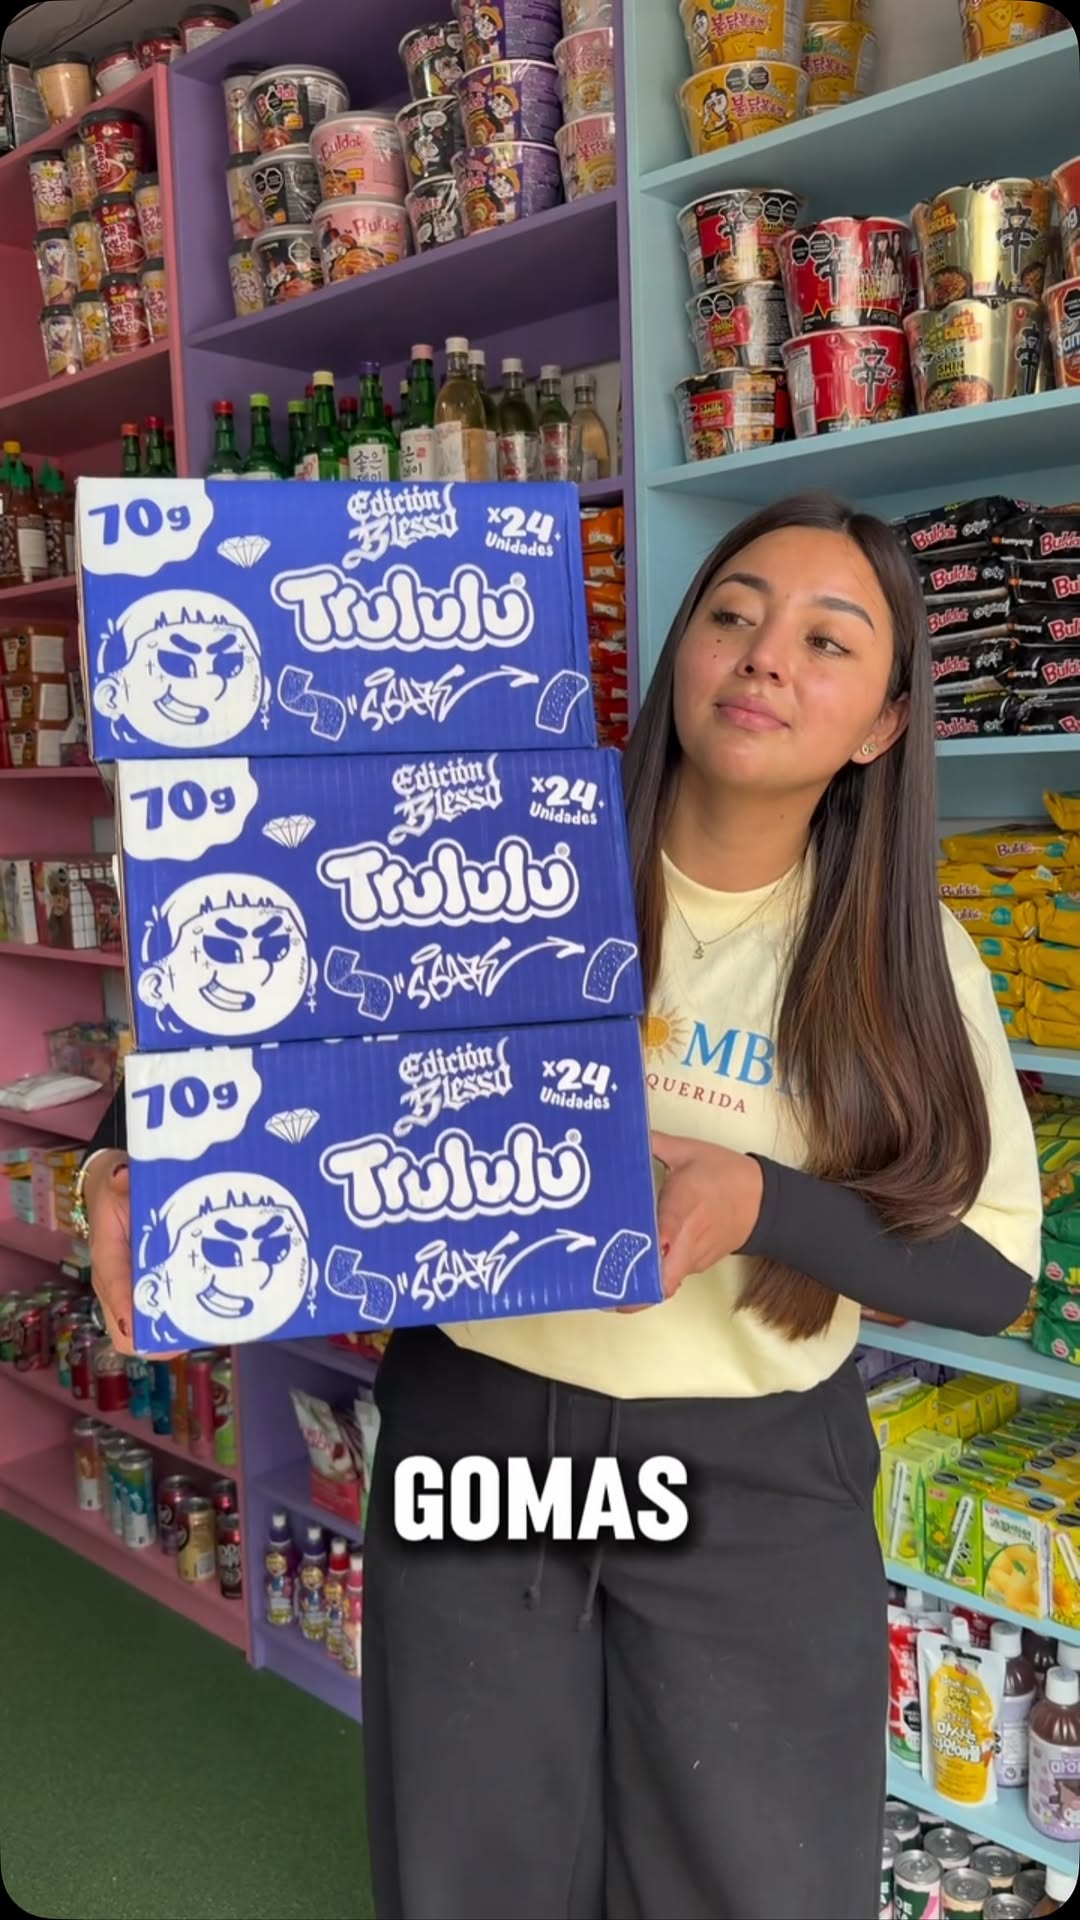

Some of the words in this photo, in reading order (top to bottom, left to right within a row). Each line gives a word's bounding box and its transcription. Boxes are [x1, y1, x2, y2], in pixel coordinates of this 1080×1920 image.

[938, 360, 965, 374] SHIN
[88, 499, 191, 546] 70g
[347, 484, 442, 522] Edición
[485, 530, 554, 558] Unidades
[487, 506, 554, 543] x24
[271, 564, 534, 653] Trululu
[392, 759, 486, 793] Edición
[531, 776, 598, 812] x24
[131, 780, 236, 832] 70g
[529, 801, 598, 825] Unidades
[316, 835, 580, 932] Trululu
[399, 1042, 495, 1086] Edición
[542, 1058, 612, 1095] x24
[681, 1020, 790, 1097] MB
[132, 1075, 239, 1130] 70g
[539, 1085, 611, 1111] Unidades
[646, 1073, 747, 1114] QUERIDA
[319, 1123, 591, 1229] Trululu
